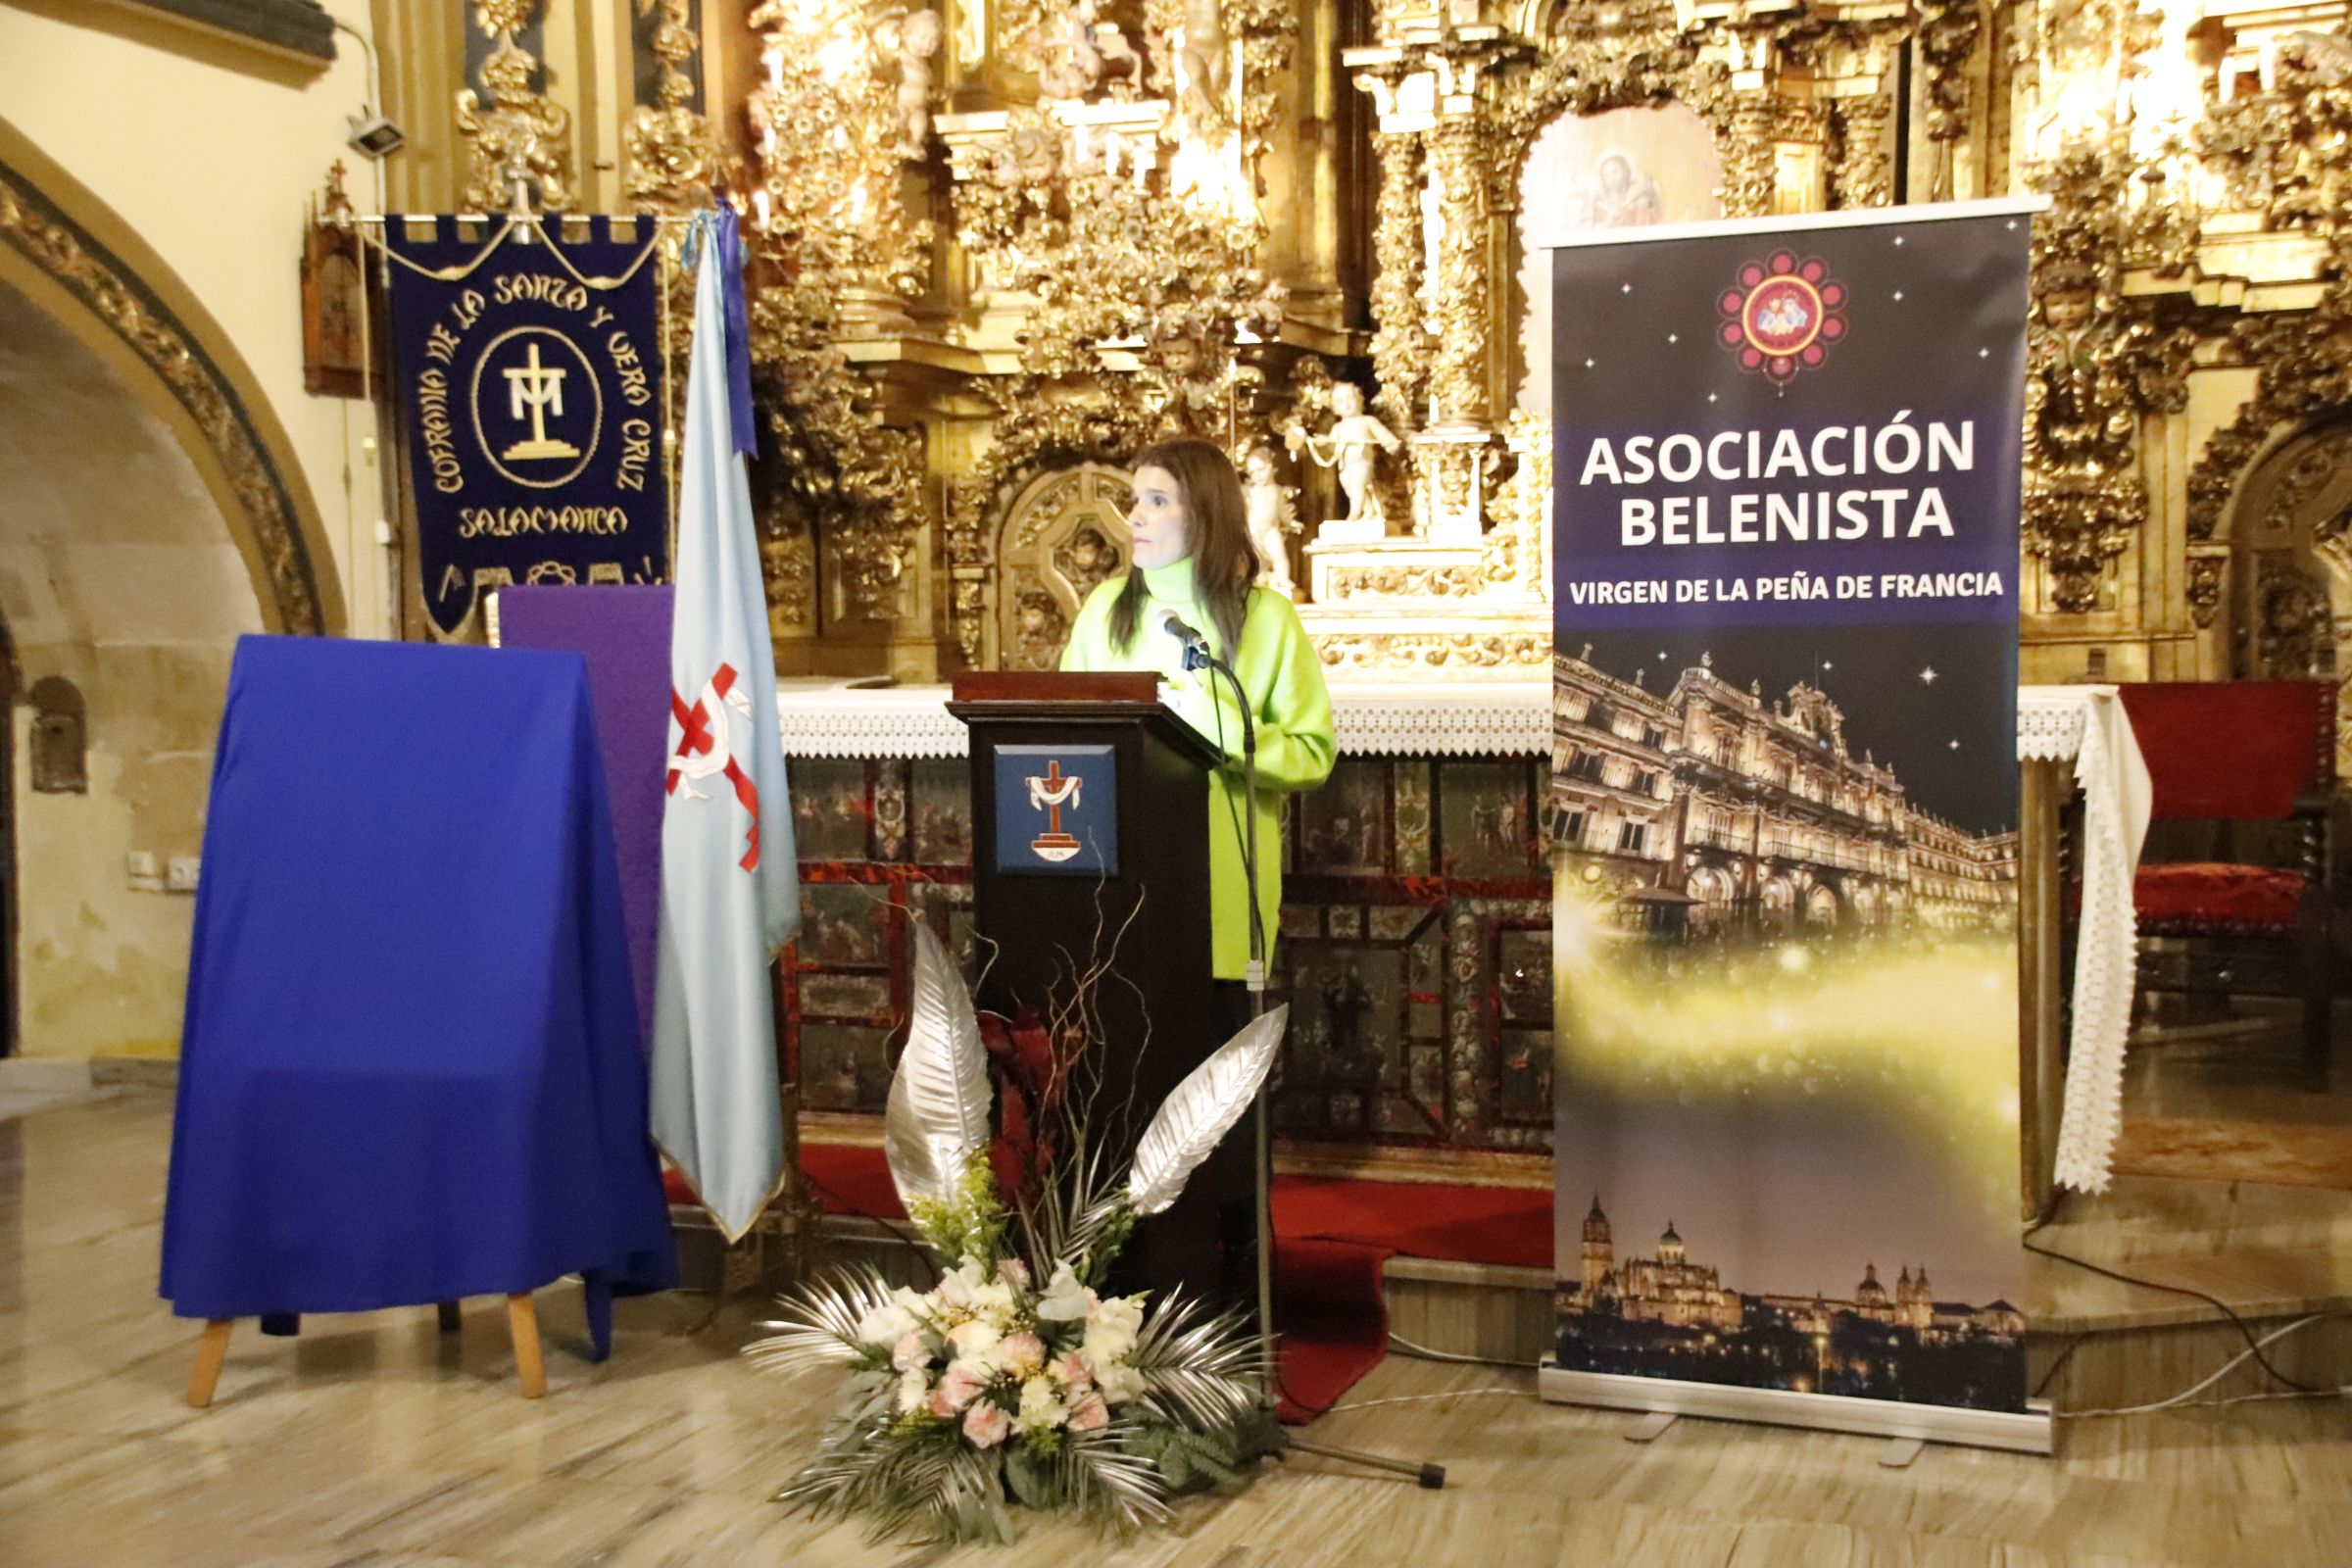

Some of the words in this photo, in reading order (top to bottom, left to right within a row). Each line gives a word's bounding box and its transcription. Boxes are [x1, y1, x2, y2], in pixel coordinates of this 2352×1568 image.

[451, 288, 486, 330] LA
[494, 272, 588, 312] SANTA
[589, 305, 614, 328] Y
[425, 322, 462, 366] DE
[608, 330, 652, 406] VERA
[418, 368, 464, 493] COFRADIA
[1579, 410, 1975, 485] ASOCIACIÓN
[616, 417, 651, 492] CRUZ
[458, 506, 628, 539] SALAMANCA
[1620, 487, 1955, 546] BELENISTA
[1569, 580, 1668, 605] VIRGEN
[1675, 578, 1709, 602] DE
[1715, 577, 1749, 602] LA
[1755, 570, 1830, 600] PEÑA
[1836, 575, 1874, 599] DE
[1880, 571, 2004, 598] FRANCIA
